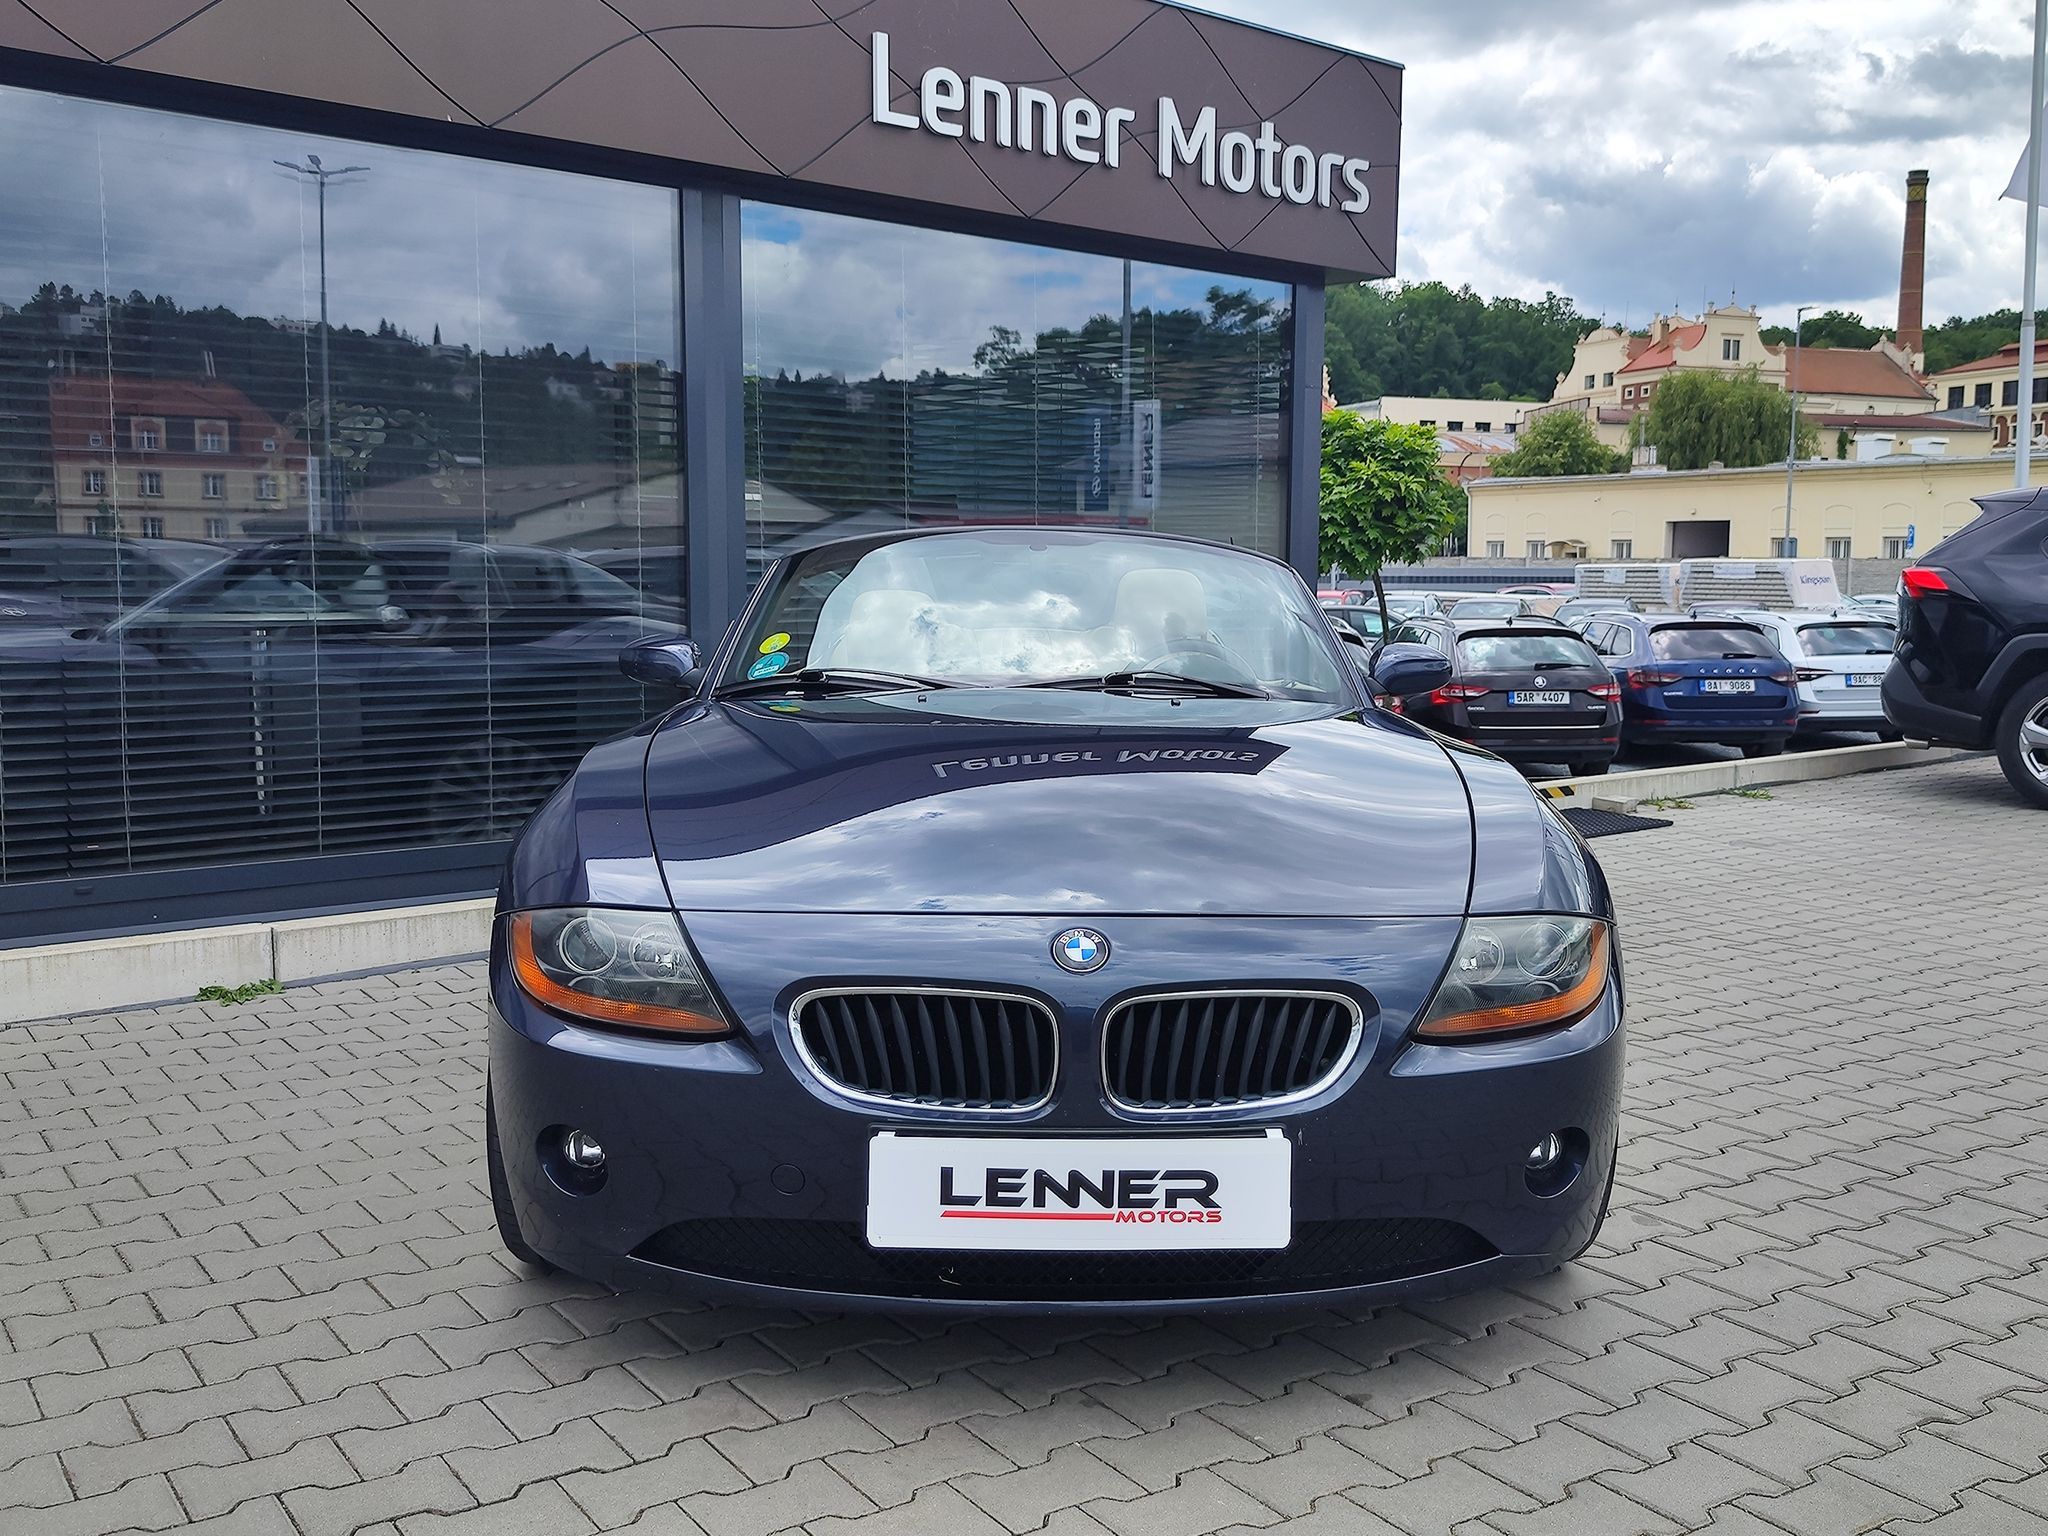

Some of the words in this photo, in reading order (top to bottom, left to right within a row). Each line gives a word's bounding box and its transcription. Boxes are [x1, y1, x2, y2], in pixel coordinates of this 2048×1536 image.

[872, 31, 1136, 169] Lenner
[1158, 96, 1371, 215] Motors
[1516, 692, 1535, 703] 5AR
[1541, 691, 1565, 703] 4407
[1060, 930, 1101, 944] BMW
[940, 1166, 1223, 1209] LENNER
[1115, 1210, 1223, 1224] MOTORS
